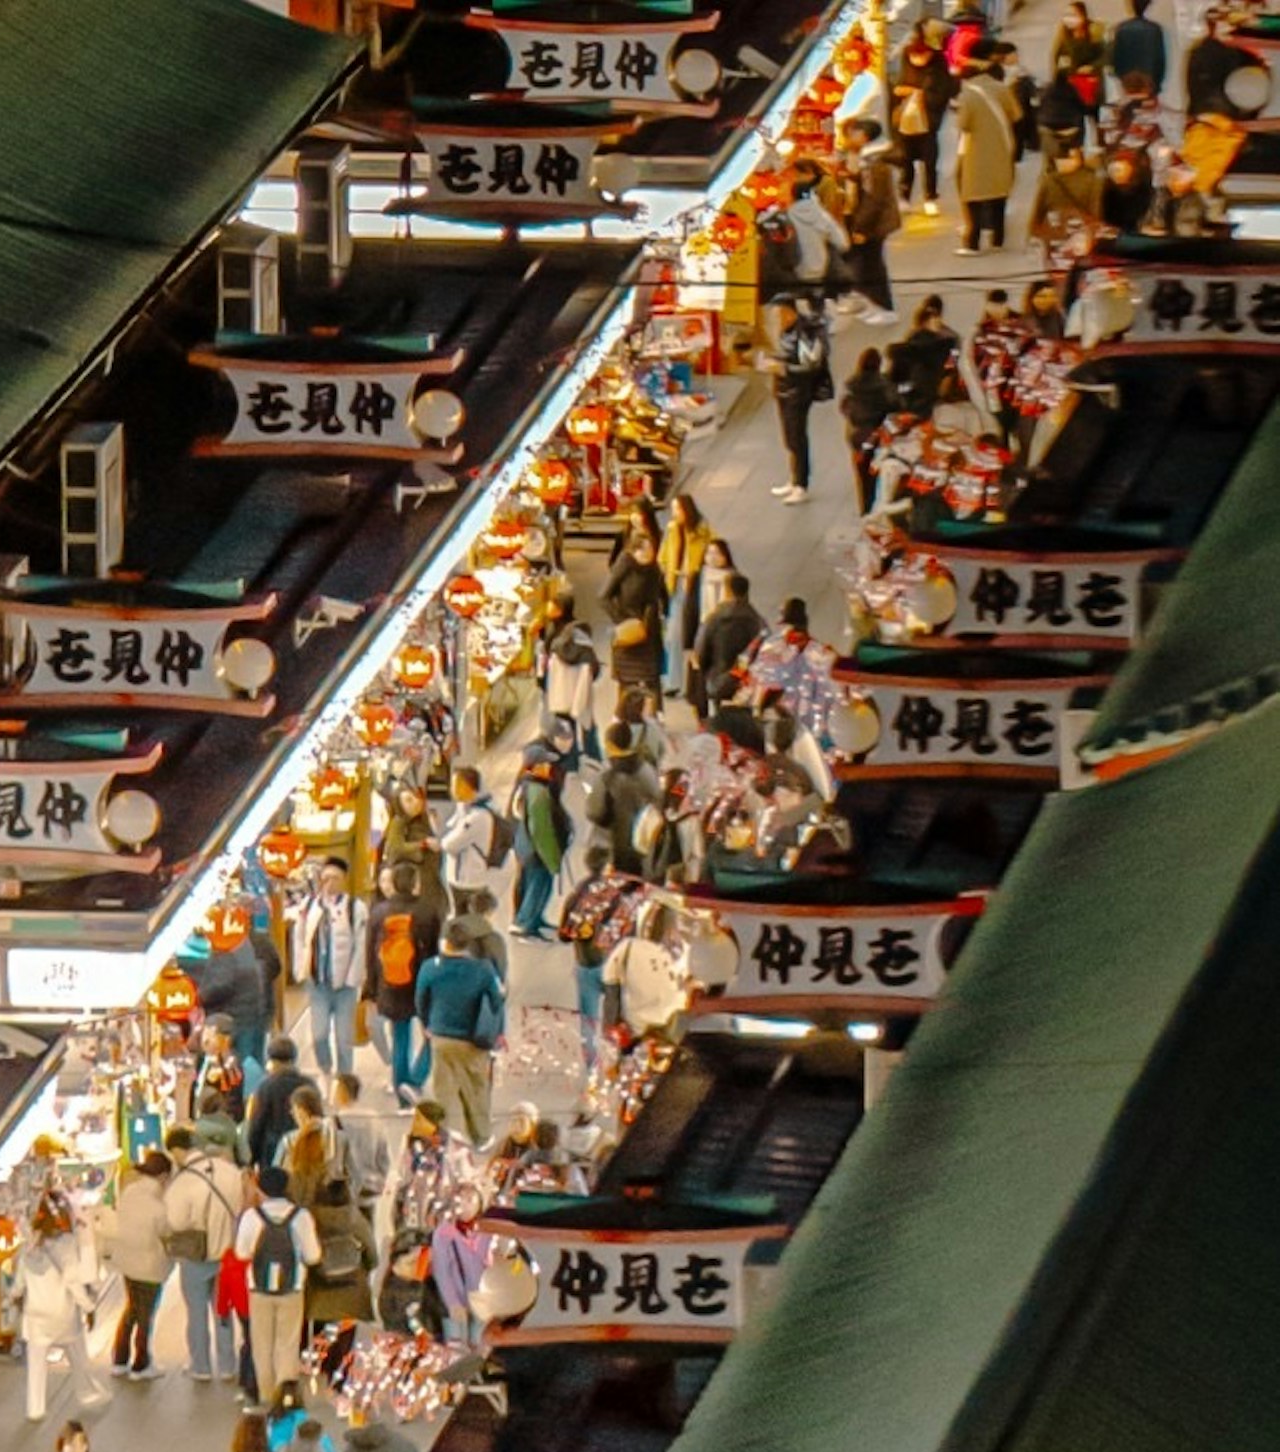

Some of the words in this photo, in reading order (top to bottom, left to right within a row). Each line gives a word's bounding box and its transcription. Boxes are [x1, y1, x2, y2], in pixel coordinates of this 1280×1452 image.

[969, 567, 1128, 627] 仲見世
[892, 694, 1055, 757] 仲見世
[751, 924, 920, 987] 仲見世
[551, 1249, 729, 1316] 仲見世
